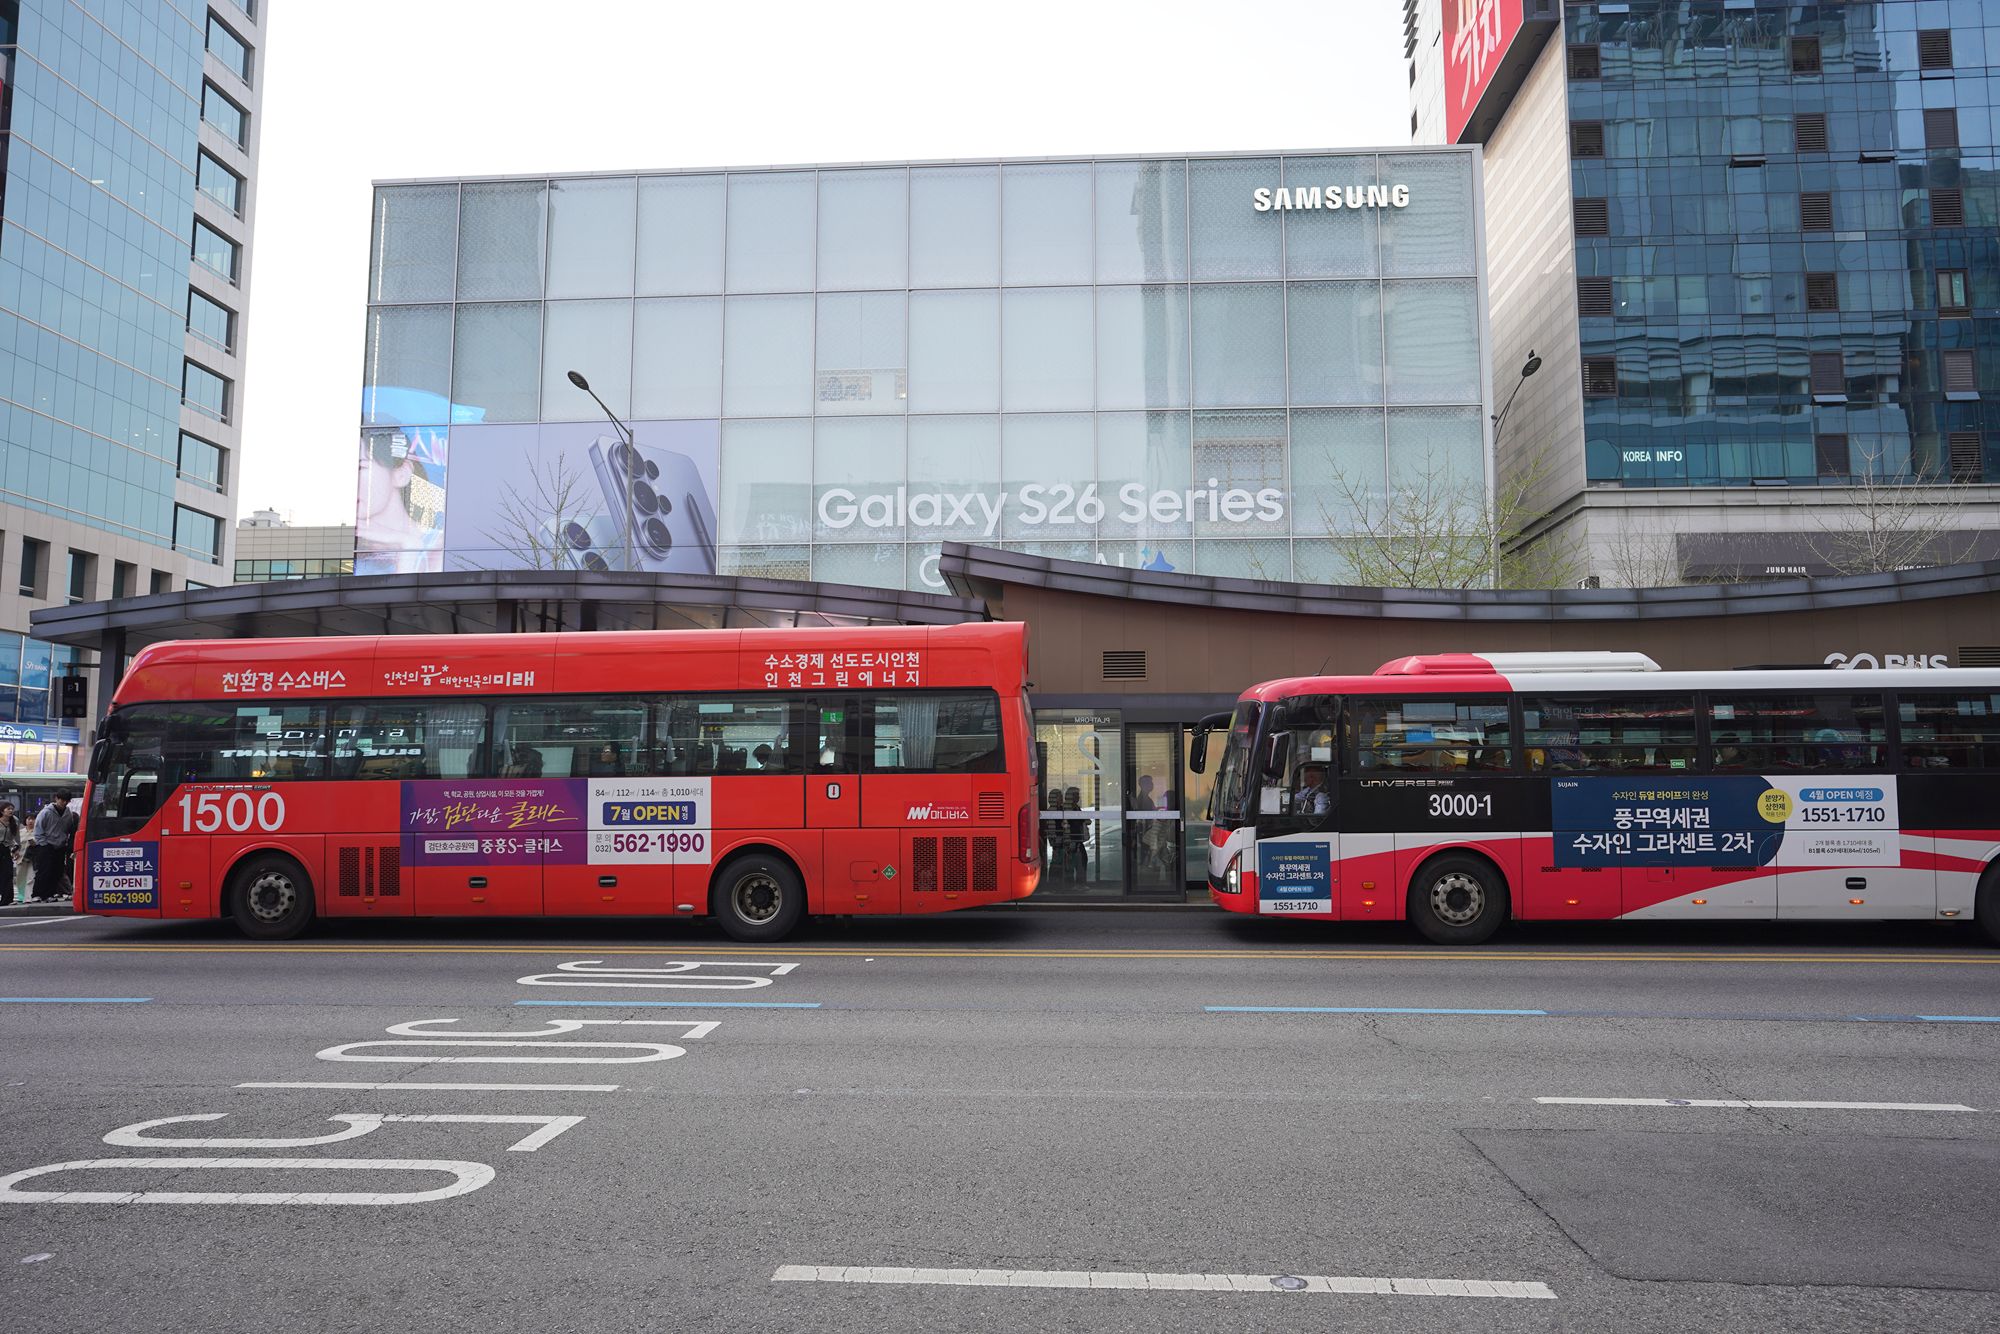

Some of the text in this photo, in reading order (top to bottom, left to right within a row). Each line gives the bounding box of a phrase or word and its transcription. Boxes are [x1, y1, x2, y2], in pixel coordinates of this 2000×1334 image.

[1253, 184, 1410, 212] SAMSUNG
[1623, 450, 1683, 463] KOREA INFO
[817, 485, 1008, 537] Galaxy
[1018, 483, 1106, 525] S26
[1118, 477, 1285, 523] Series
[1765, 565, 1807, 574] JUNO HAIR
[764, 652, 921, 670] 수소경제 선도도시인천
[221, 668, 347, 693] 친환경 수소버스
[493, 671, 535, 688] 미래
[1360, 779, 1436, 788] UNIVERSE
[1612, 791, 1709, 801] 수자인 듀얼 라이프의 완성
[1764, 794, 1786, 803] 분양가
[1808, 789, 1873, 801] 4월 OPEN 예정
[178, 791, 286, 832] 1500
[610, 805, 631, 821] 7월
[632, 805, 680, 821] OPEN
[1428, 794, 1492, 817] 3000-1
[1764, 803, 1786, 811] 상한제
[1612, 807, 1711, 831] 풍무역세권
[1801, 807, 1885, 824] 1551-1710
[595, 833, 705, 853] 032) 562-1990
[1572, 832, 1755, 855] 수자인 그라센트 2차
[112, 877, 143, 888] OPEN
[1265, 872, 1286, 881] 수자인
[103, 892, 152, 904] 562-1990
[1273, 901, 1318, 911] 1551-1710
